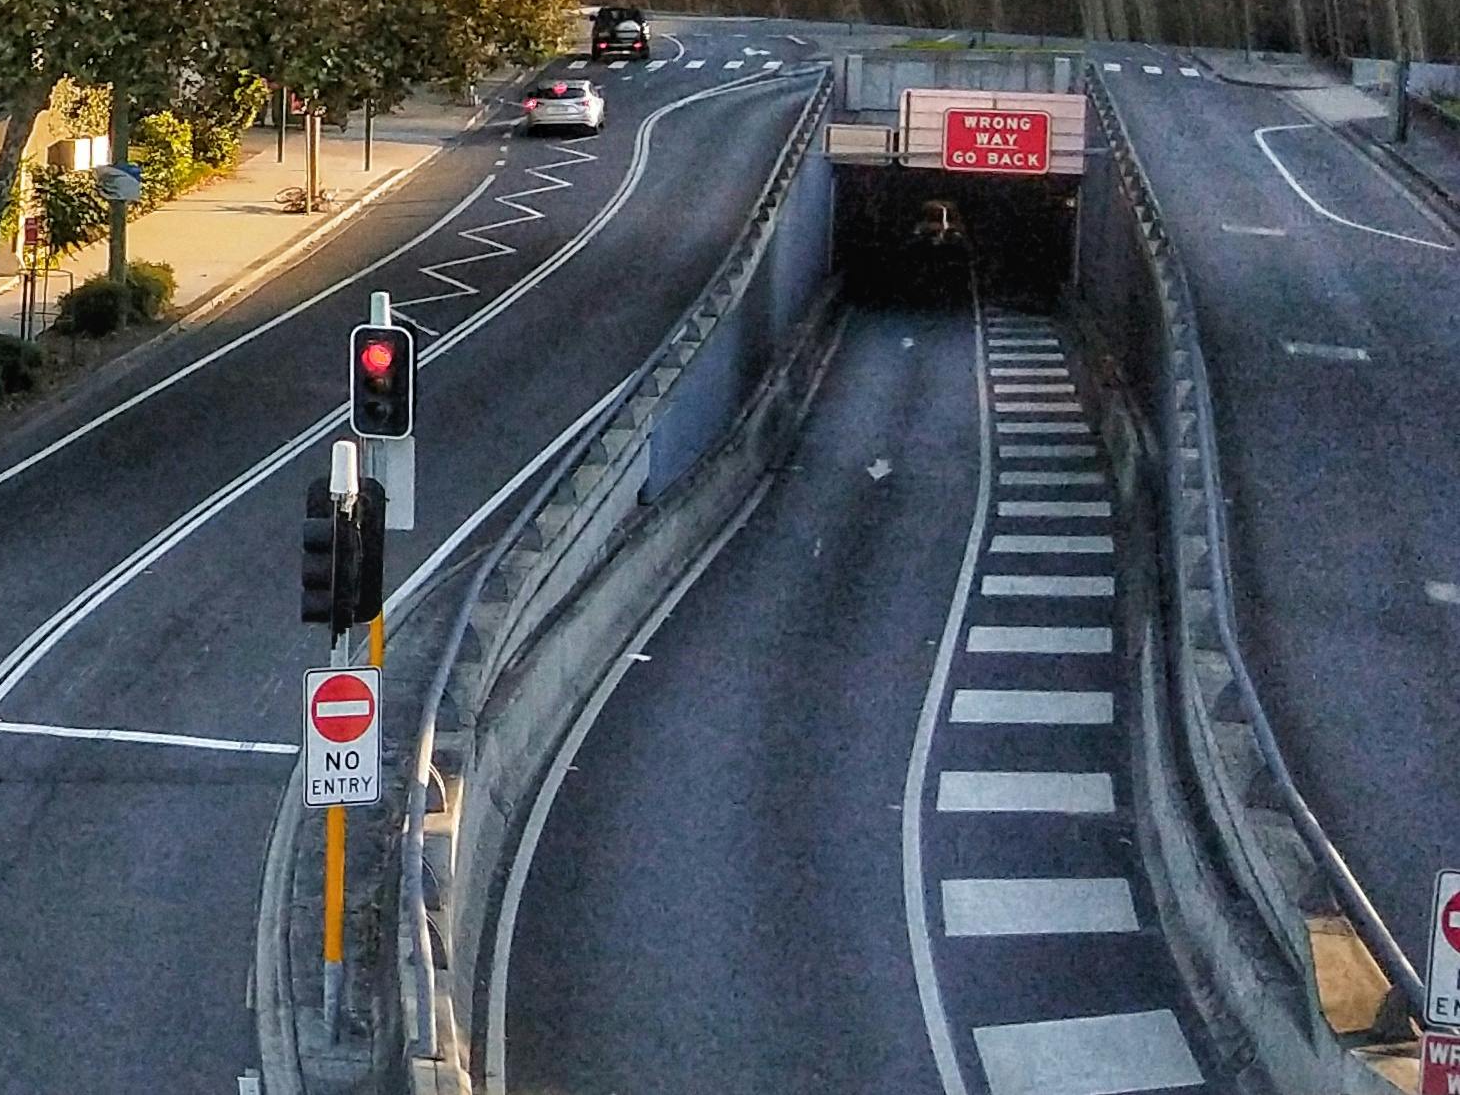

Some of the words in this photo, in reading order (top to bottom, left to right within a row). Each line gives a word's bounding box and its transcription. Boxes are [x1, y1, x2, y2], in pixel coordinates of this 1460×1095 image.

[963, 116, 1031, 131] WRONG
[975, 132, 1018, 146] WAY
[952, 151, 977, 164] GO
[987, 152, 1040, 167] BACK
[326, 750, 360, 772] NO
[312, 776, 373, 796] ENTRY
